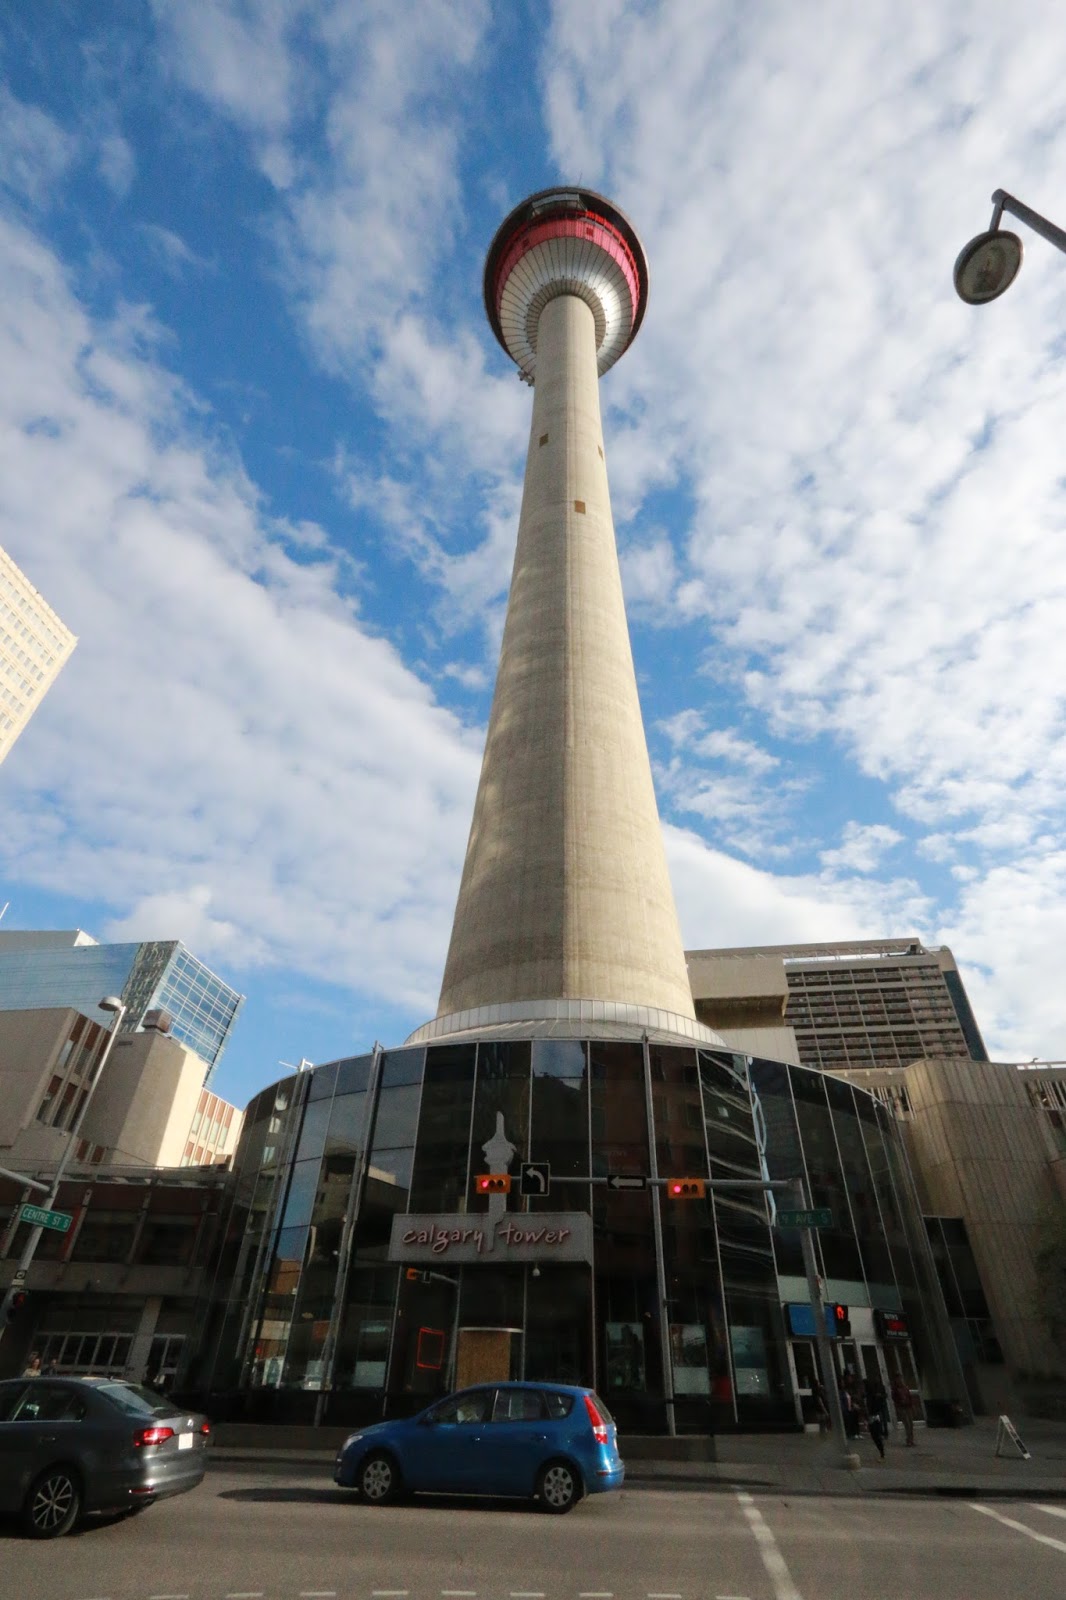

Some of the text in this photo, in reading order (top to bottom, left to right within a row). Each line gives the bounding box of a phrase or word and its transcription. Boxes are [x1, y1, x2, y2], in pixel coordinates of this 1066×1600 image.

[22, 1208, 50, 1223] CENTRE
[52, 1216, 61, 1226] ST
[63, 1218, 69, 1229] S
[795, 1213, 814, 1224] AVE
[820, 1212, 828, 1223] S
[402, 1223, 569, 1252] calgary tower
